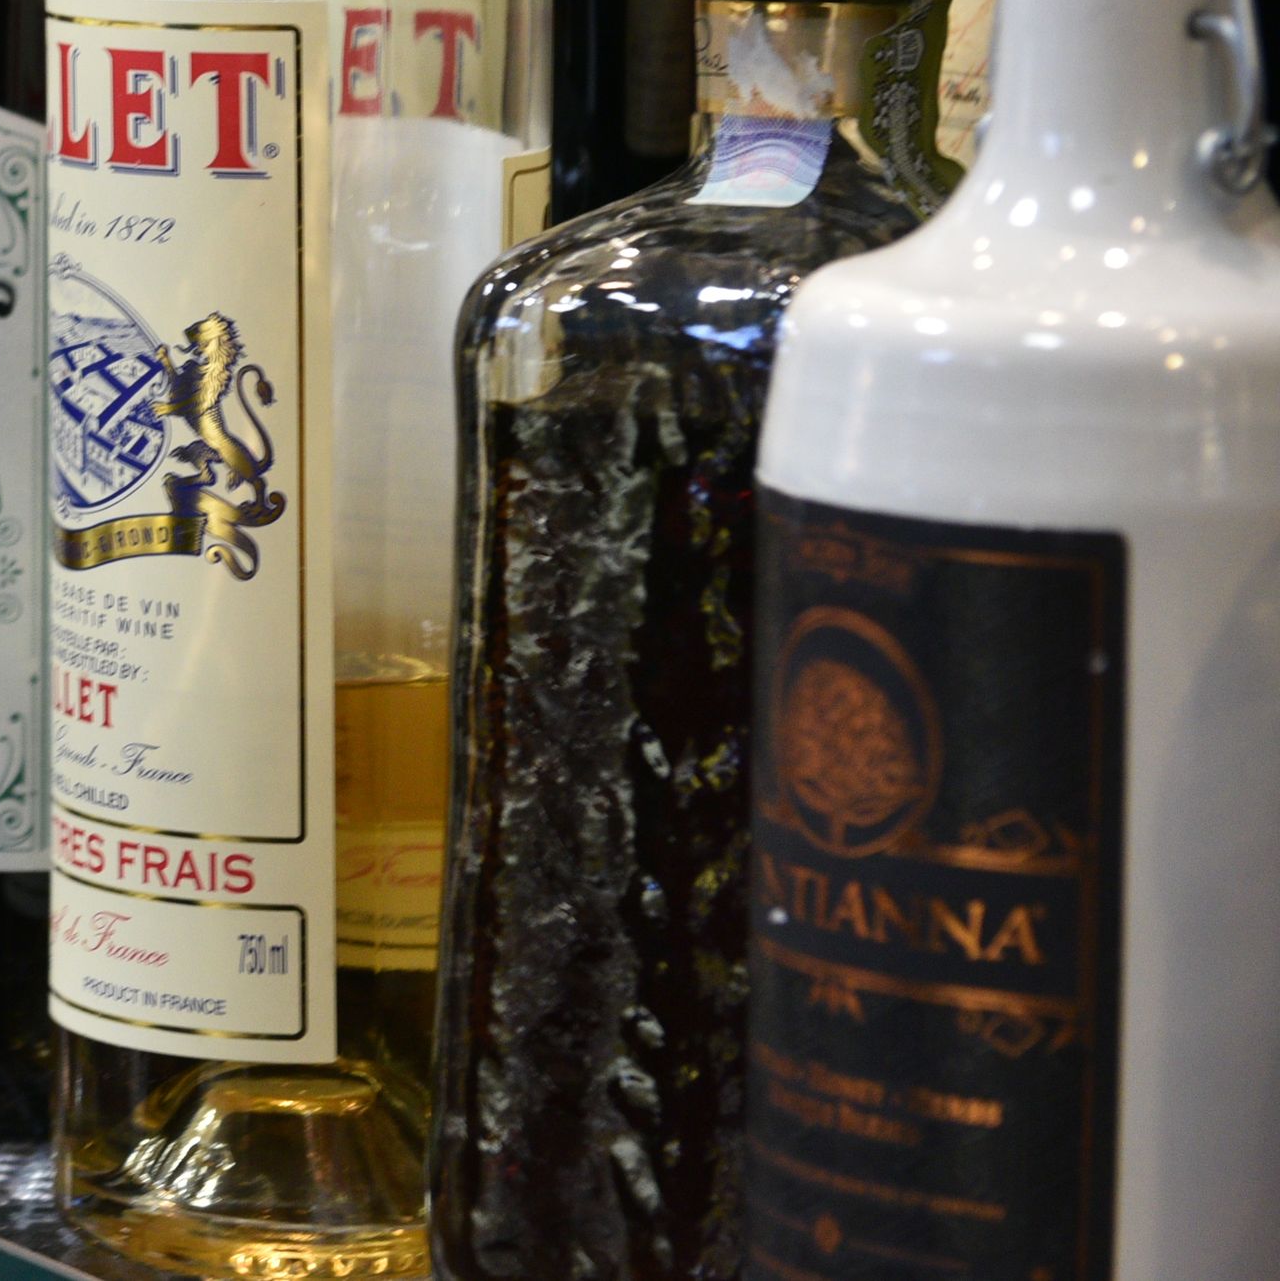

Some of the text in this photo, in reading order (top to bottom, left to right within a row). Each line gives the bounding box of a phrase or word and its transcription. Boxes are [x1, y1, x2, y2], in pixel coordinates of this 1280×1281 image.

[338, 8, 480, 120] ET
[47, 41, 285, 180] LET
[103, 214, 177, 244] 1872
[103, 593, 128, 612] DE
[140, 599, 180, 619] VIN
[116, 617, 175, 639] WINE
[110, 742, 194, 784] France
[117, 839, 256, 895] FRAIS
[81, 910, 171, 967] France
[238, 934, 290, 975] 750 ml
[159, 993, 227, 1016] FRANCE
